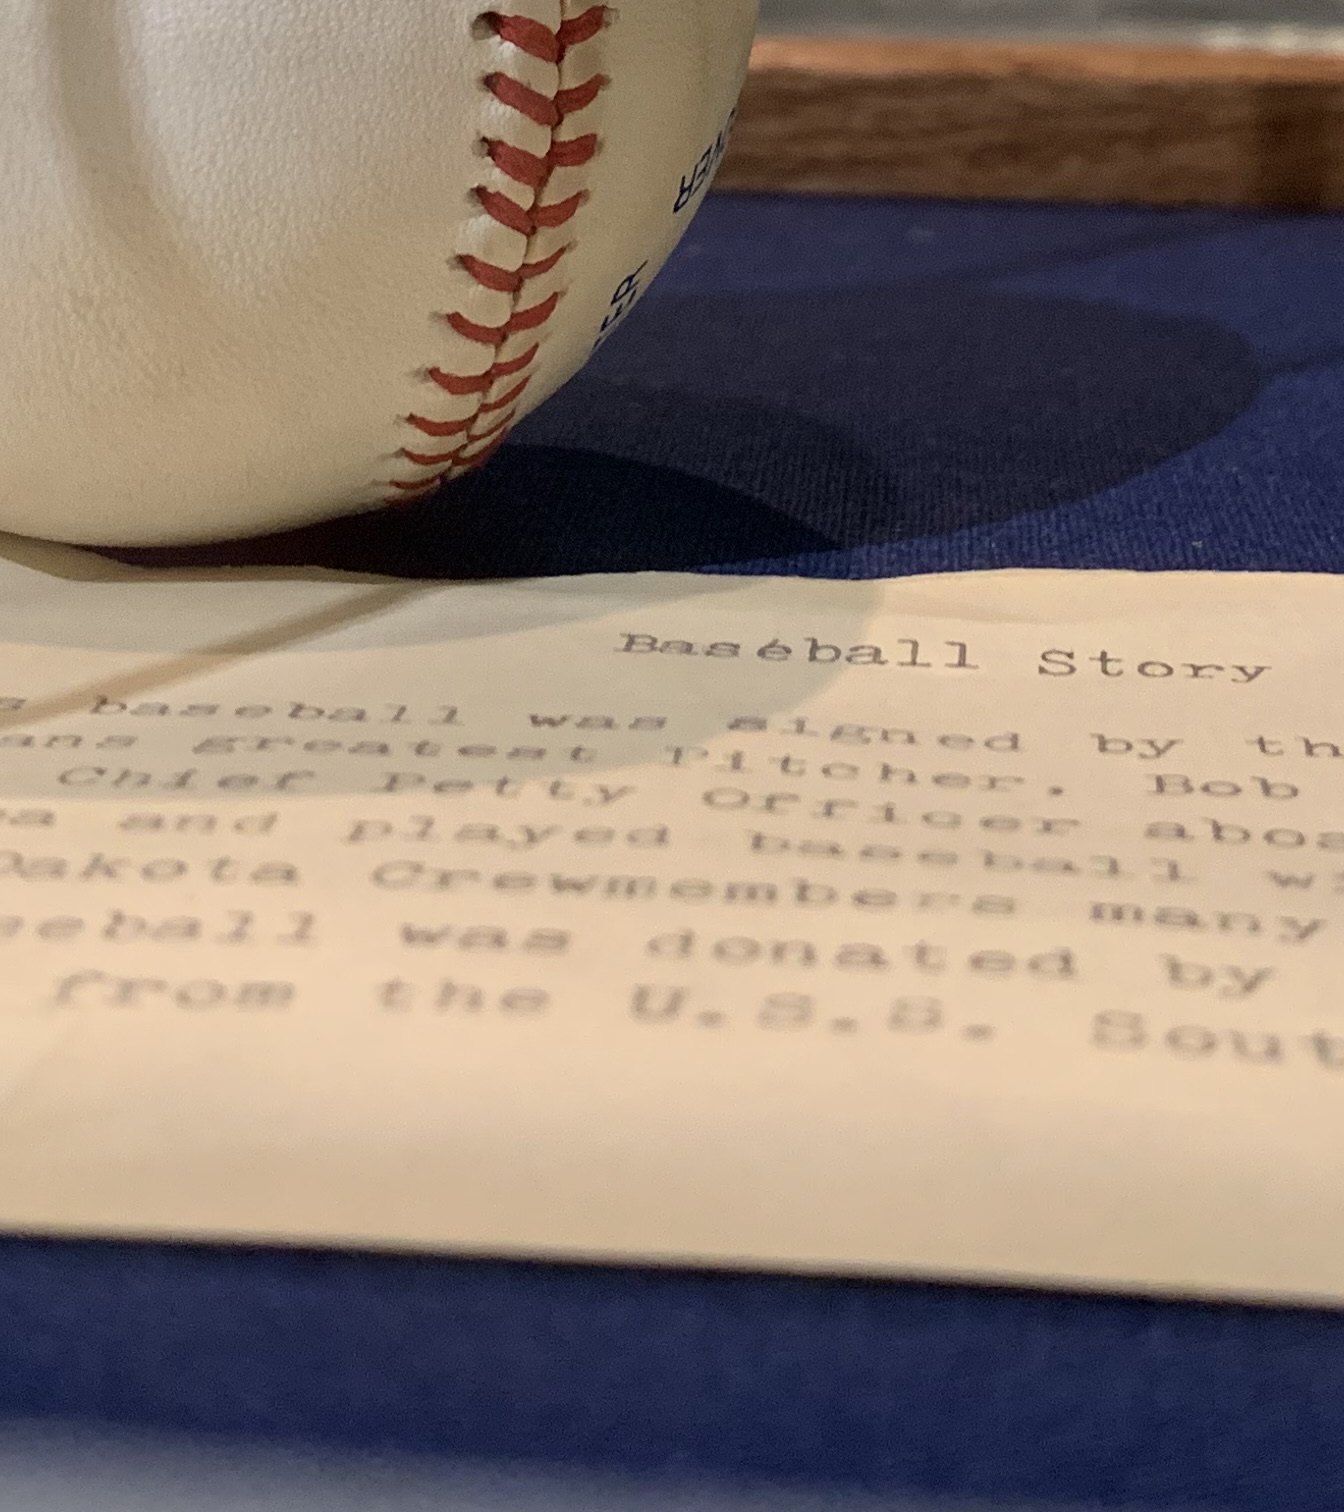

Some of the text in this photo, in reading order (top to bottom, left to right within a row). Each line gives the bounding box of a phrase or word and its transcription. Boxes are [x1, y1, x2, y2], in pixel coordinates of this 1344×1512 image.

[1036, 646, 1273, 688] Story
[90, 692, 464, 727] baseball
[526, 712, 670, 732] was
[724, 714, 1026, 756] signed
[1090, 732, 1182, 762] by
[56, 762, 322, 794] Chief
[702, 786, 1082, 835] Officer
[190, 734, 602, 764] greatest
[1148, 772, 1302, 804] Bob
[118, 806, 282, 840] and
[344, 816, 672, 854] played
[746, 822, 1200, 884] baseball
[372, 860, 1016, 915] Crewmembers
[1086, 898, 1330, 944] many
[396, 922, 572, 958] was
[644, 924, 1080, 980] donated
[1156, 948, 1280, 996] by
[46, 972, 298, 1012] from
[376, 976, 552, 1018] the
